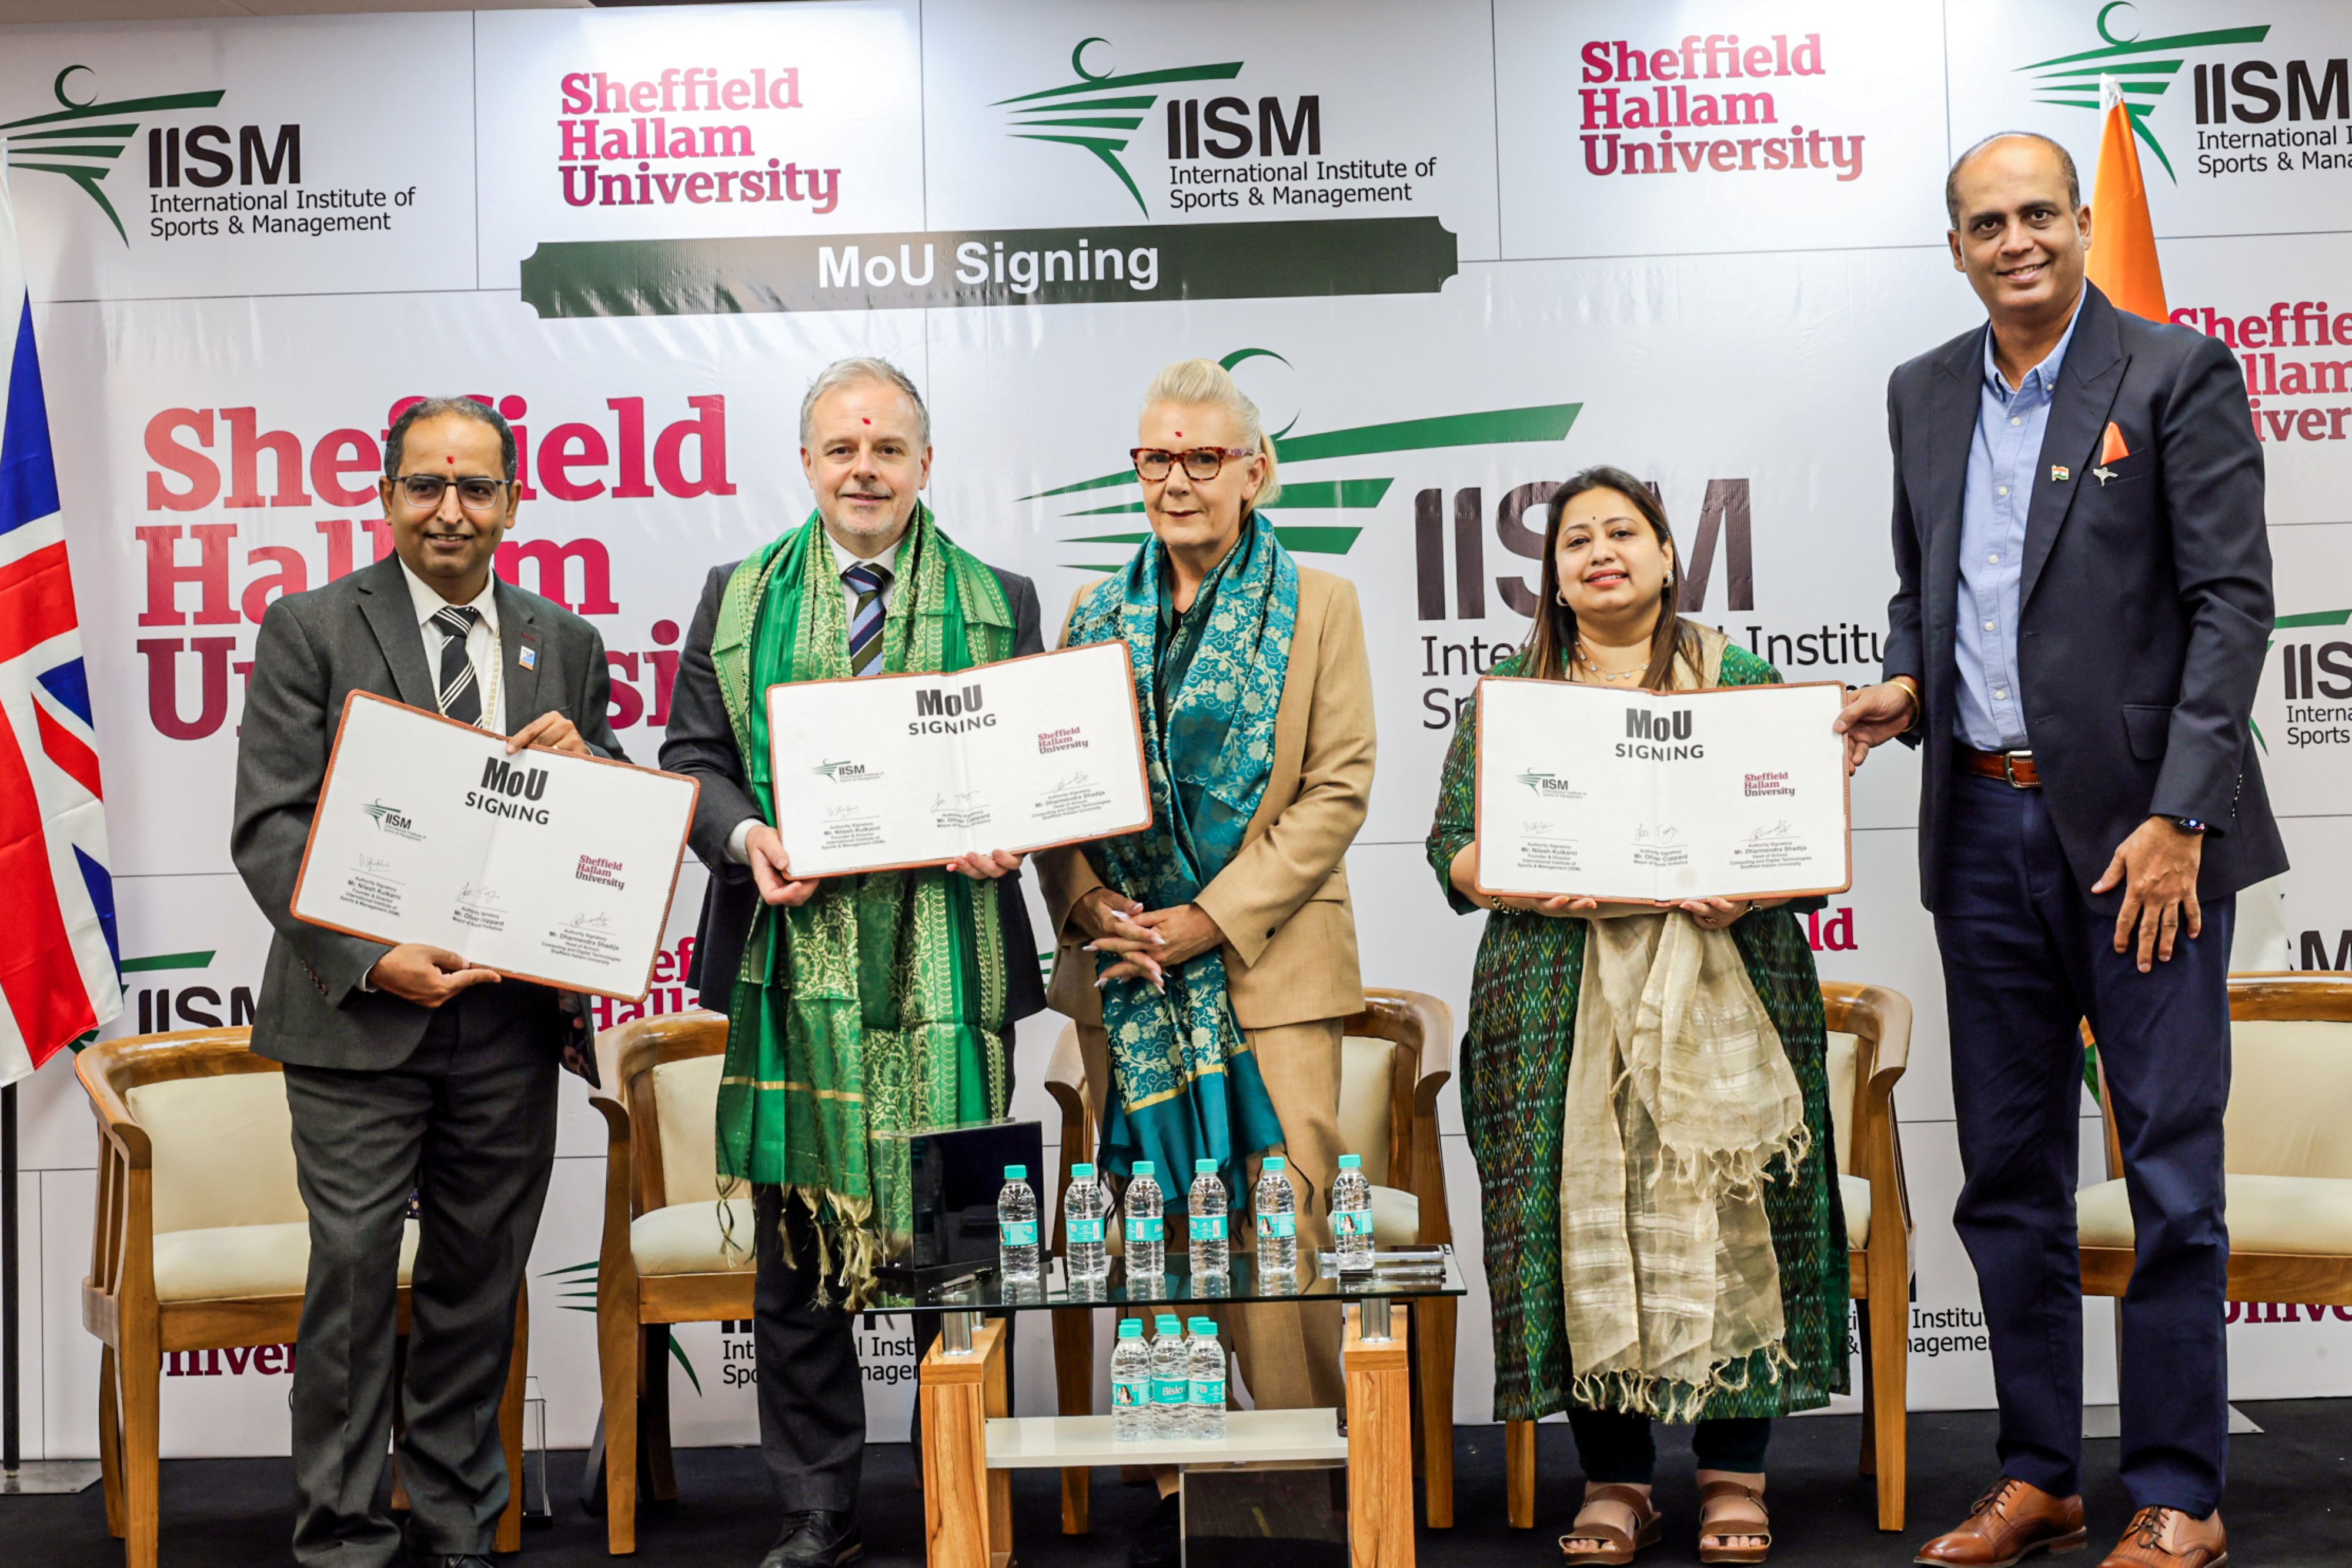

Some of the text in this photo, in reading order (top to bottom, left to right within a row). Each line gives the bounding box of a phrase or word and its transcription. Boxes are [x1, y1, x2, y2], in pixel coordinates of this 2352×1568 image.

[1581, 33, 1826, 83] Sheffield
[560, 66, 803, 115] Sheffield
[2194, 59, 2350, 125] IISM
[1578, 85, 1778, 130] Hallam
[557, 117, 755, 162] Hallam
[1167, 95, 1321, 160] IISM
[2197, 125, 2337, 149] International
[149, 124, 300, 188] IISM
[1579, 125, 1865, 182] University
[2198, 152, 2268, 178] Sports
[2277, 152, 2294, 170] &
[1170, 157, 1438, 185] International Institute of
[150, 186, 416, 214] International Institute of
[557, 158, 842, 215] University
[1170, 183, 1413, 213] Sports & Management
[150, 212, 392, 240] Sports & Management
[818, 238, 1159, 295] MoU Signing
[916, 684, 983, 717] MoU
[908, 713, 997, 735] SIGNING
[1038, 726, 1080, 740] Sheffield
[1626, 708, 1692, 742] MoU
[2287, 727, 2350, 748] Sports
[1038, 737, 1073, 748] Hallam
[1039, 740, 1088, 754] University
[1615, 743, 1704, 762] SIGNING
[480, 756, 549, 801] MoU
[838, 764, 865, 775] IISM
[1744, 772, 1789, 781] Sheffield
[1542, 778, 1568, 790] IISM
[1744, 787, 1795, 797] University
[386, 813, 412, 830] IISM
[465, 791, 550, 825] SIGNING
[577, 862, 612, 877] Hallam
[579, 855, 623, 870] Sheffield
[576, 871, 625, 891] University
[559, 933, 596, 945] Dharmendra
[597, 941, 619, 951] Shadija
